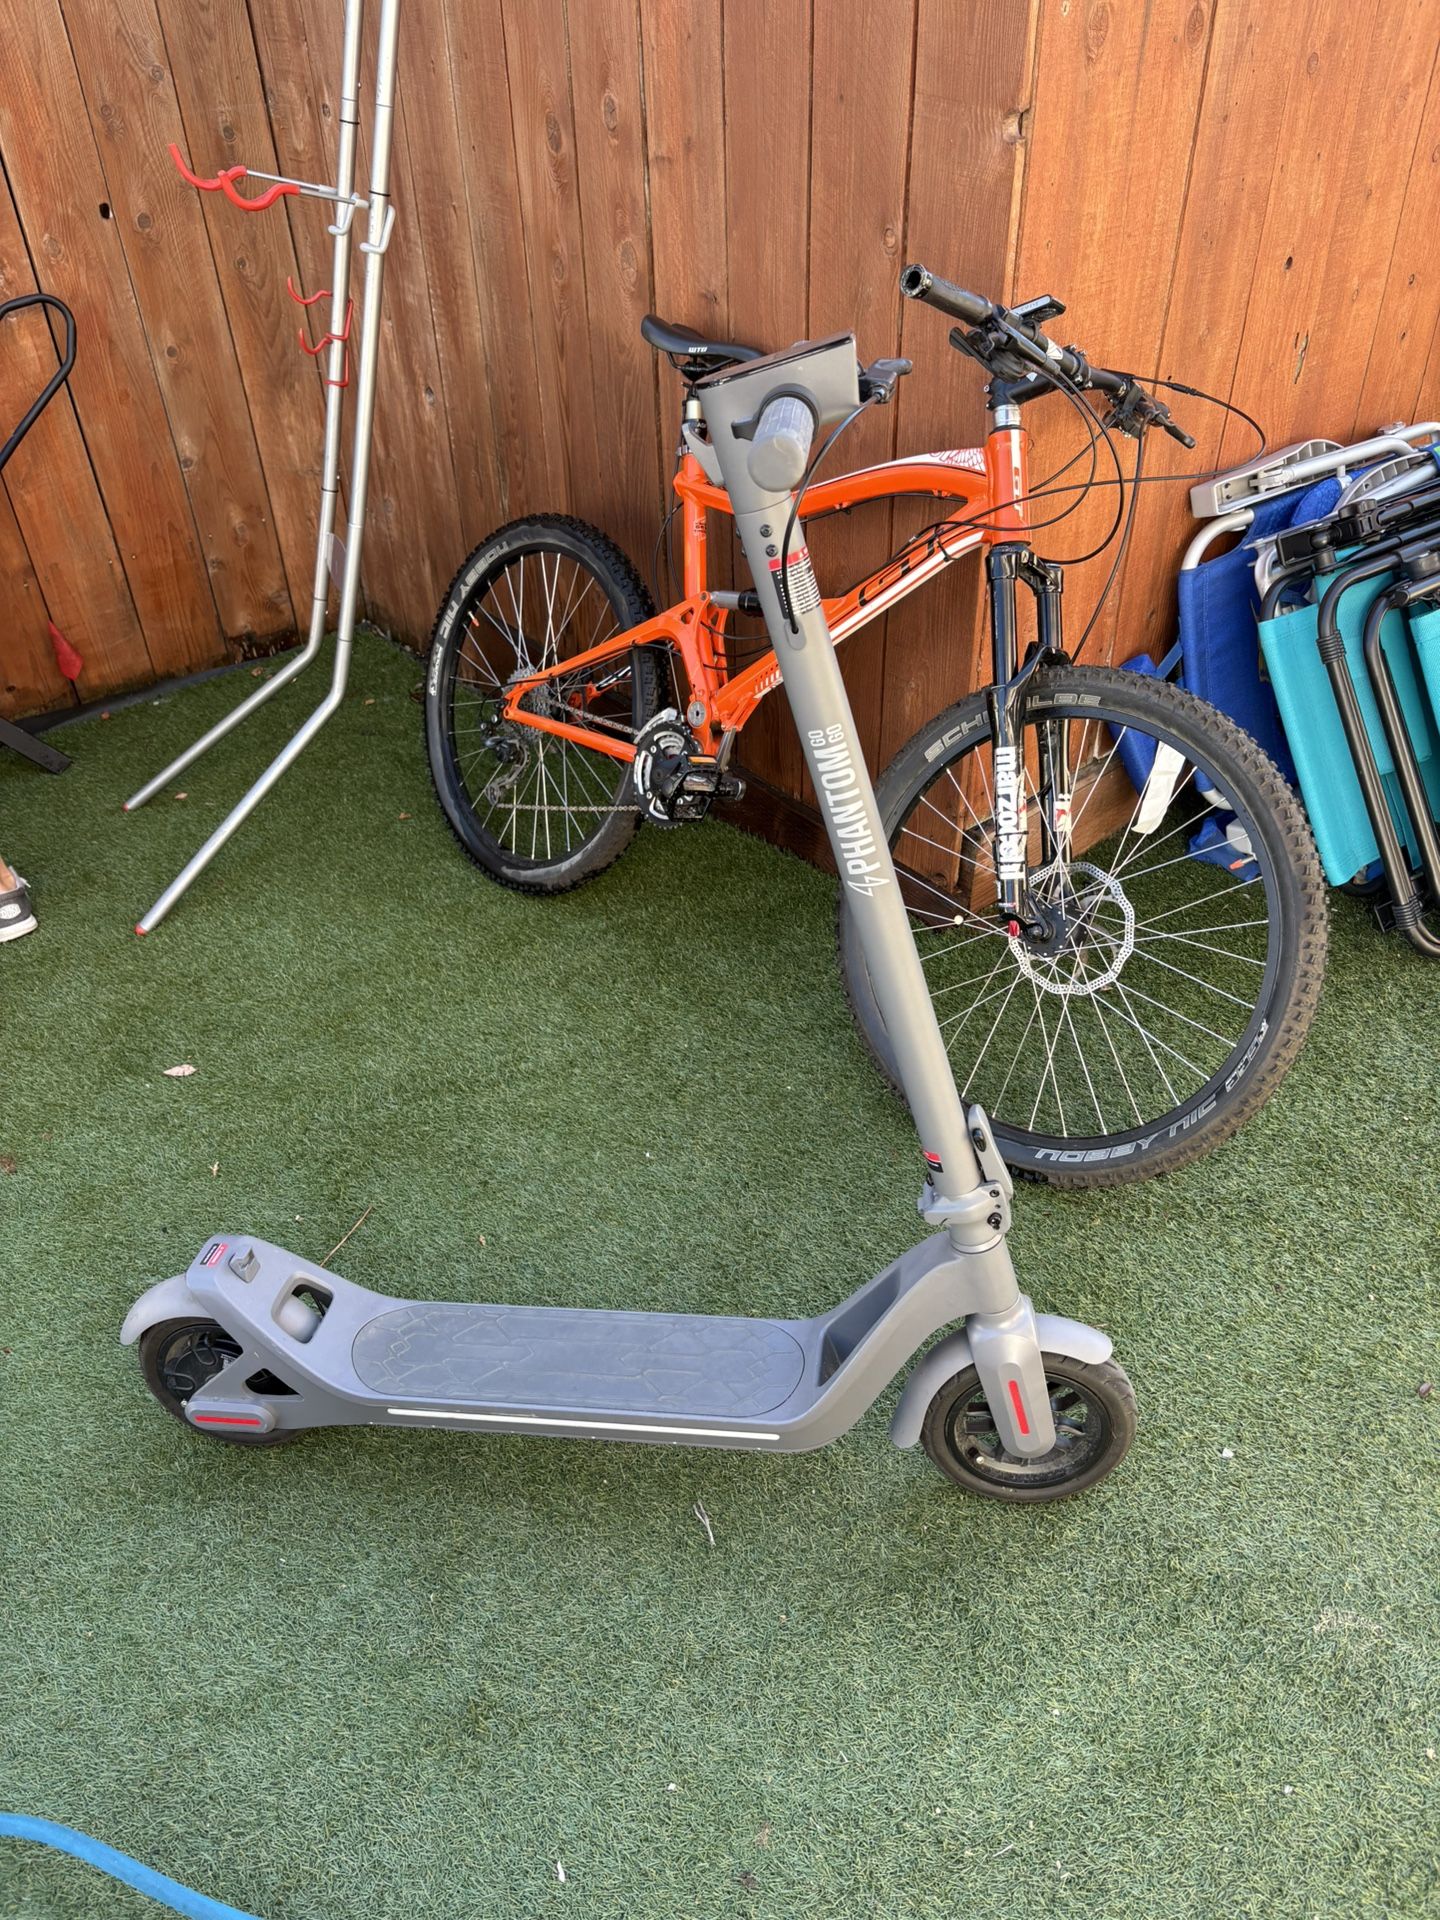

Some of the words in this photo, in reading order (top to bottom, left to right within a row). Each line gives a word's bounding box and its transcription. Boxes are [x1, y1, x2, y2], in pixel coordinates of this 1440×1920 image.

[459, 541, 510, 600] NOBBY
[439, 602, 460, 639] NIC
[808, 729, 827, 747] GO
[826, 723, 844, 744] GO
[813, 741, 881, 875] PHANTOM
[1034, 1131, 1161, 1163] NOBBY
[1169, 1094, 1218, 1138] NIC
